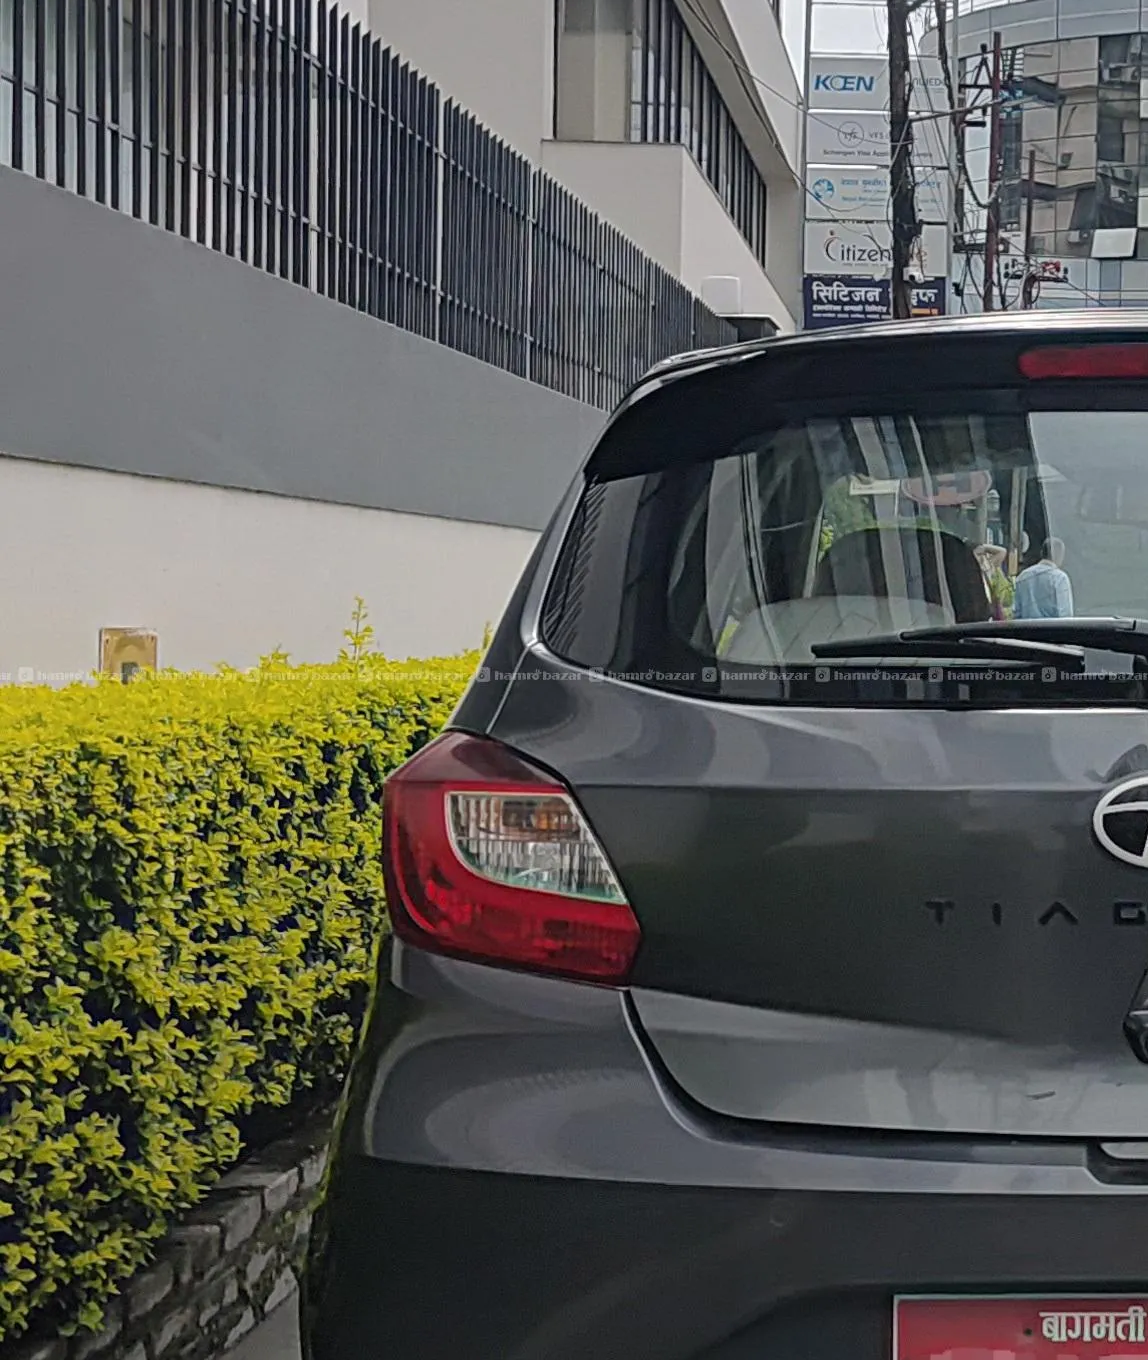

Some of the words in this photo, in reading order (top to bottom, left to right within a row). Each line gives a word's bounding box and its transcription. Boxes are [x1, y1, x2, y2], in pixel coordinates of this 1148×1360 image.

[824, 236, 891, 262] Citizen
[812, 281, 882, 303] सिटिजन
[1039, 1306, 1147, 1342] बागमती
